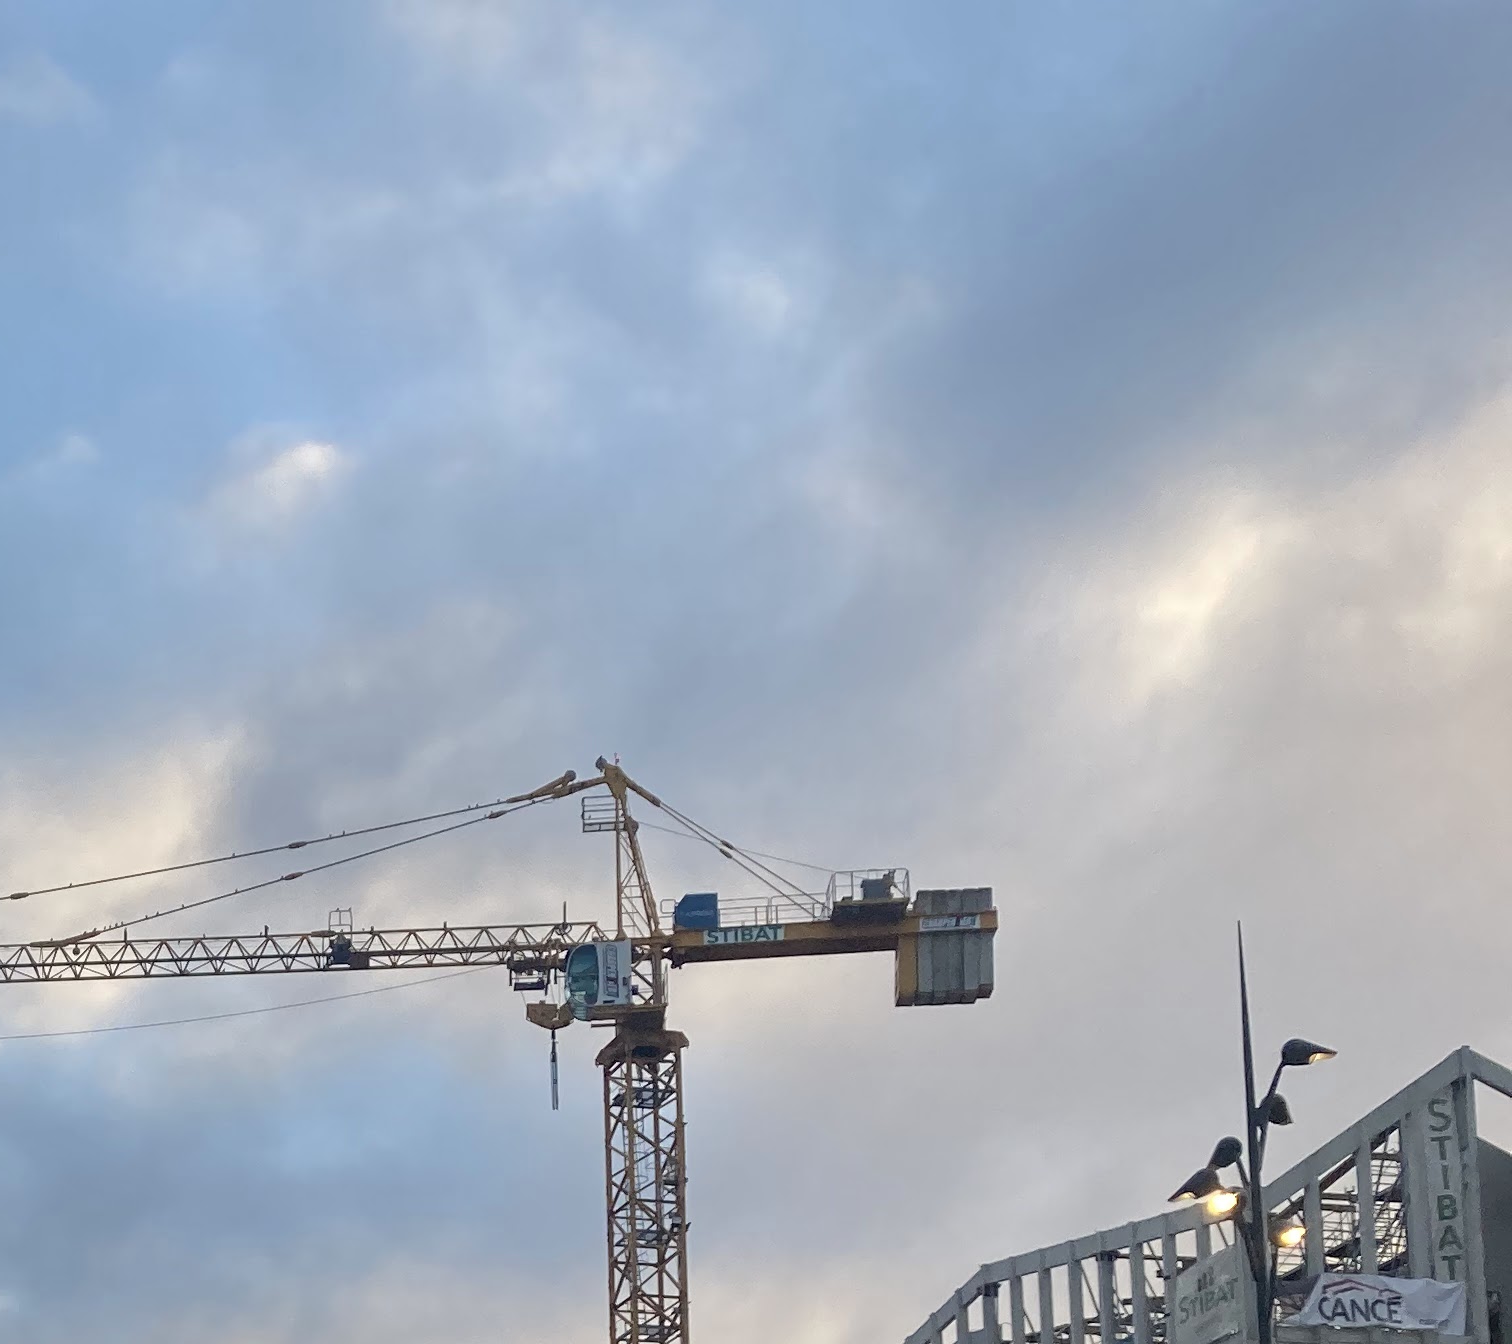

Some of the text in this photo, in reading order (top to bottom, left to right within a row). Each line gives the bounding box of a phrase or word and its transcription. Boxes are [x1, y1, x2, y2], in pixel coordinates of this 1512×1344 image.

[706, 924, 783, 944] STIBAT
[1426, 1097, 1463, 1281] STIBAT
[1178, 1276, 1239, 1325] STIBAT
